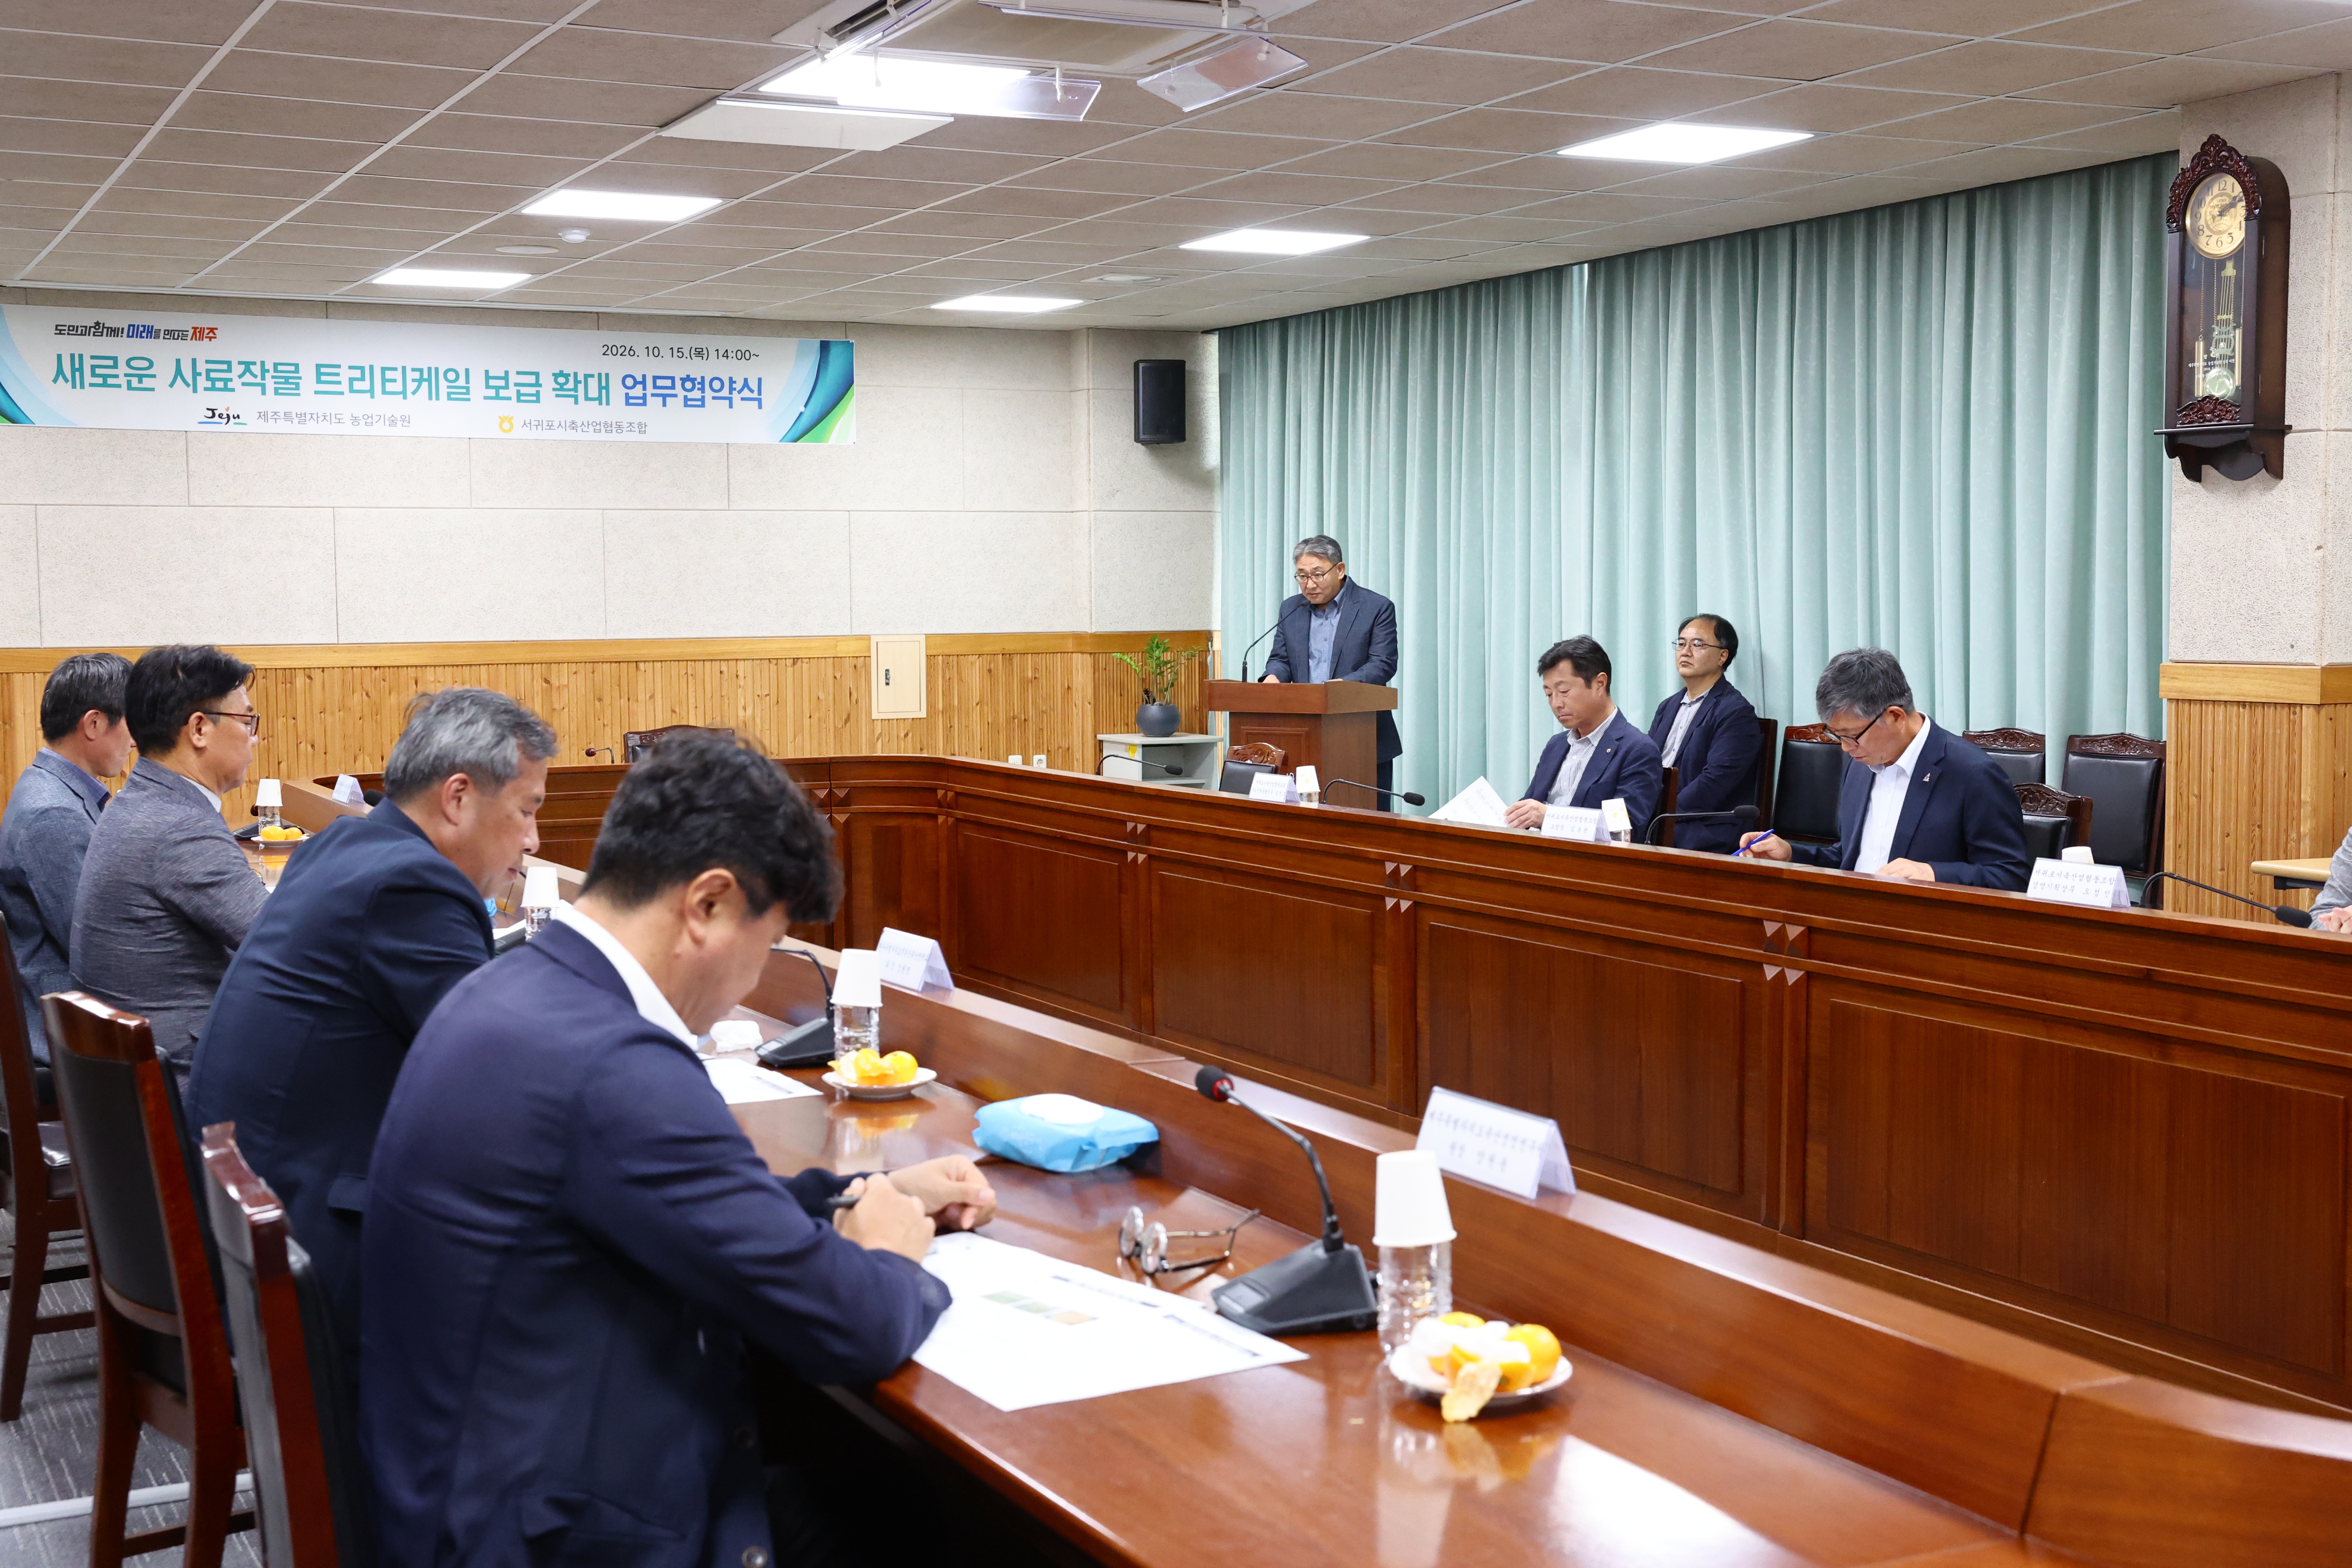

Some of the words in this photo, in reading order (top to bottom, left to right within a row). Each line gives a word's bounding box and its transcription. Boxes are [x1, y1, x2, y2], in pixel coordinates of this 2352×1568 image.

[2207, 185, 2213, 196] 11
[2218, 180, 2227, 191] 12
[2231, 181, 2234, 193] 1
[2197, 197, 2206, 209] 10
[2195, 211, 2201, 222] 9
[2198, 225, 2205, 236] 8
[2234, 220, 2243, 231] 4
[2206, 235, 2212, 246] 7
[2216, 236, 2223, 248] 6
[2227, 232, 2234, 244] 5
[127, 324, 161, 339] 미래를
[190, 326, 218, 341] 제주
[602, 344, 639, 358] 2026.
[644, 346, 664, 358] 10.
[669, 346, 709, 361] 15.(목)
[715, 348, 759, 361] 14:00~
[52, 353, 156, 392] 새로운
[168, 358, 302, 396] 사료작물
[314, 363, 471, 401] 트리티케일
[483, 369, 543, 404] 보급
[552, 370, 610, 406] 확대
[621, 374, 762, 410] 업무협약식
[204, 407, 240, 425] Jeju
[257, 410, 345, 425] 제주특별자치도
[350, 414, 411, 427] 농업기술원
[521, 419, 648, 434] 서귀포시축산업협동조합
[2035, 869, 2115, 886] 서귀포시축산업협동조합
[2033, 881, 2075, 893] 경영기획상무
